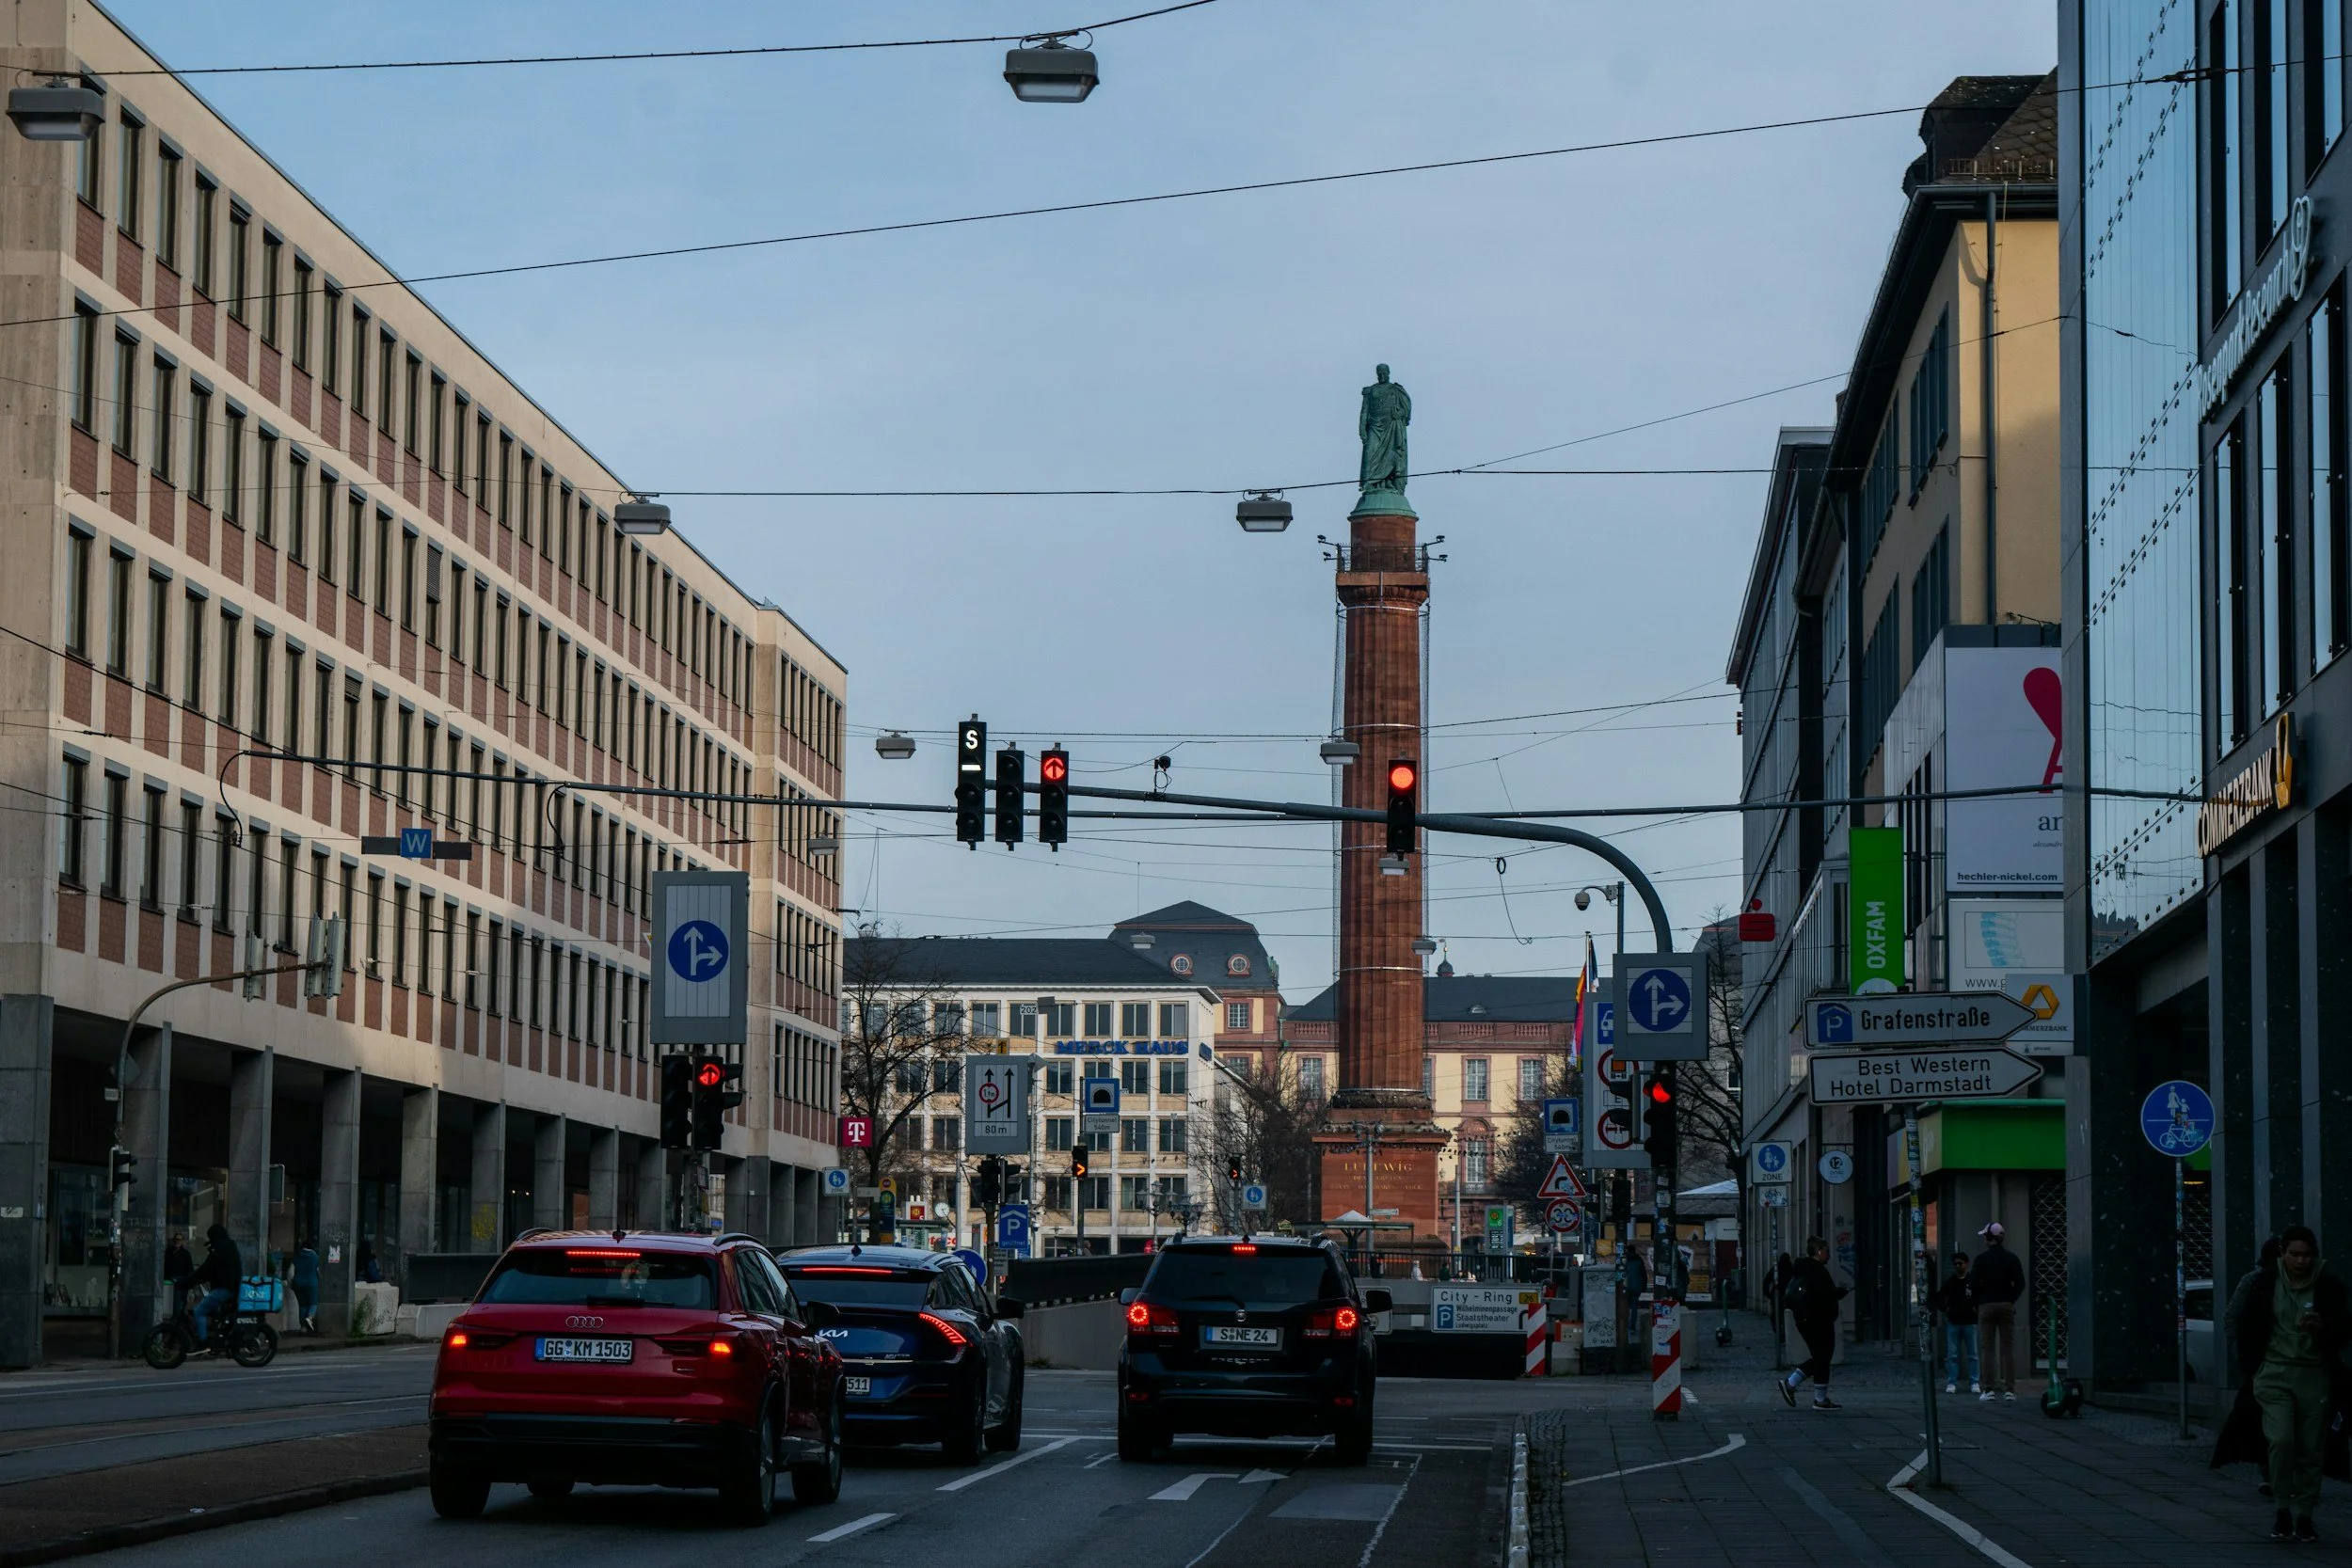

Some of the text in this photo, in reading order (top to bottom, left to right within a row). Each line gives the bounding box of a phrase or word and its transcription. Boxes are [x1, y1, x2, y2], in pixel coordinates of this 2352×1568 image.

[965, 729, 979, 750] S
[2198, 747, 2273, 859] COMMERZBANK
[405, 832, 427, 853] W
[1957, 872, 2058, 881] hechler-nickel.com
[1866, 900, 1886, 970] OXFAM
[1021, 1006, 1037, 1014] 202
[1861, 1006, 1990, 1031] Grafenstraße
[1056, 1040, 1129, 1054] MERCK
[1133, 1040, 1189, 1054] HAUS
[1858, 1057, 1991, 1076] Best Western
[1831, 1075, 1992, 1097] Hotel Darmstadt
[985, 1125, 996, 1133] 80
[1547, 1136, 1577, 1146] Citytunnel
[1007, 1218, 1021, 1236] P
[1440, 1291, 1469, 1304] City
[1484, 1291, 1513, 1305] Ring
[1455, 1305, 1518, 1313] Wilhelminenpassage
[1440, 1311, 1509, 1326] P Staatstheater
[1220, 1328, 1268, 1342] S NE 24
[546, 1340, 631, 1358] GG KM 1503
